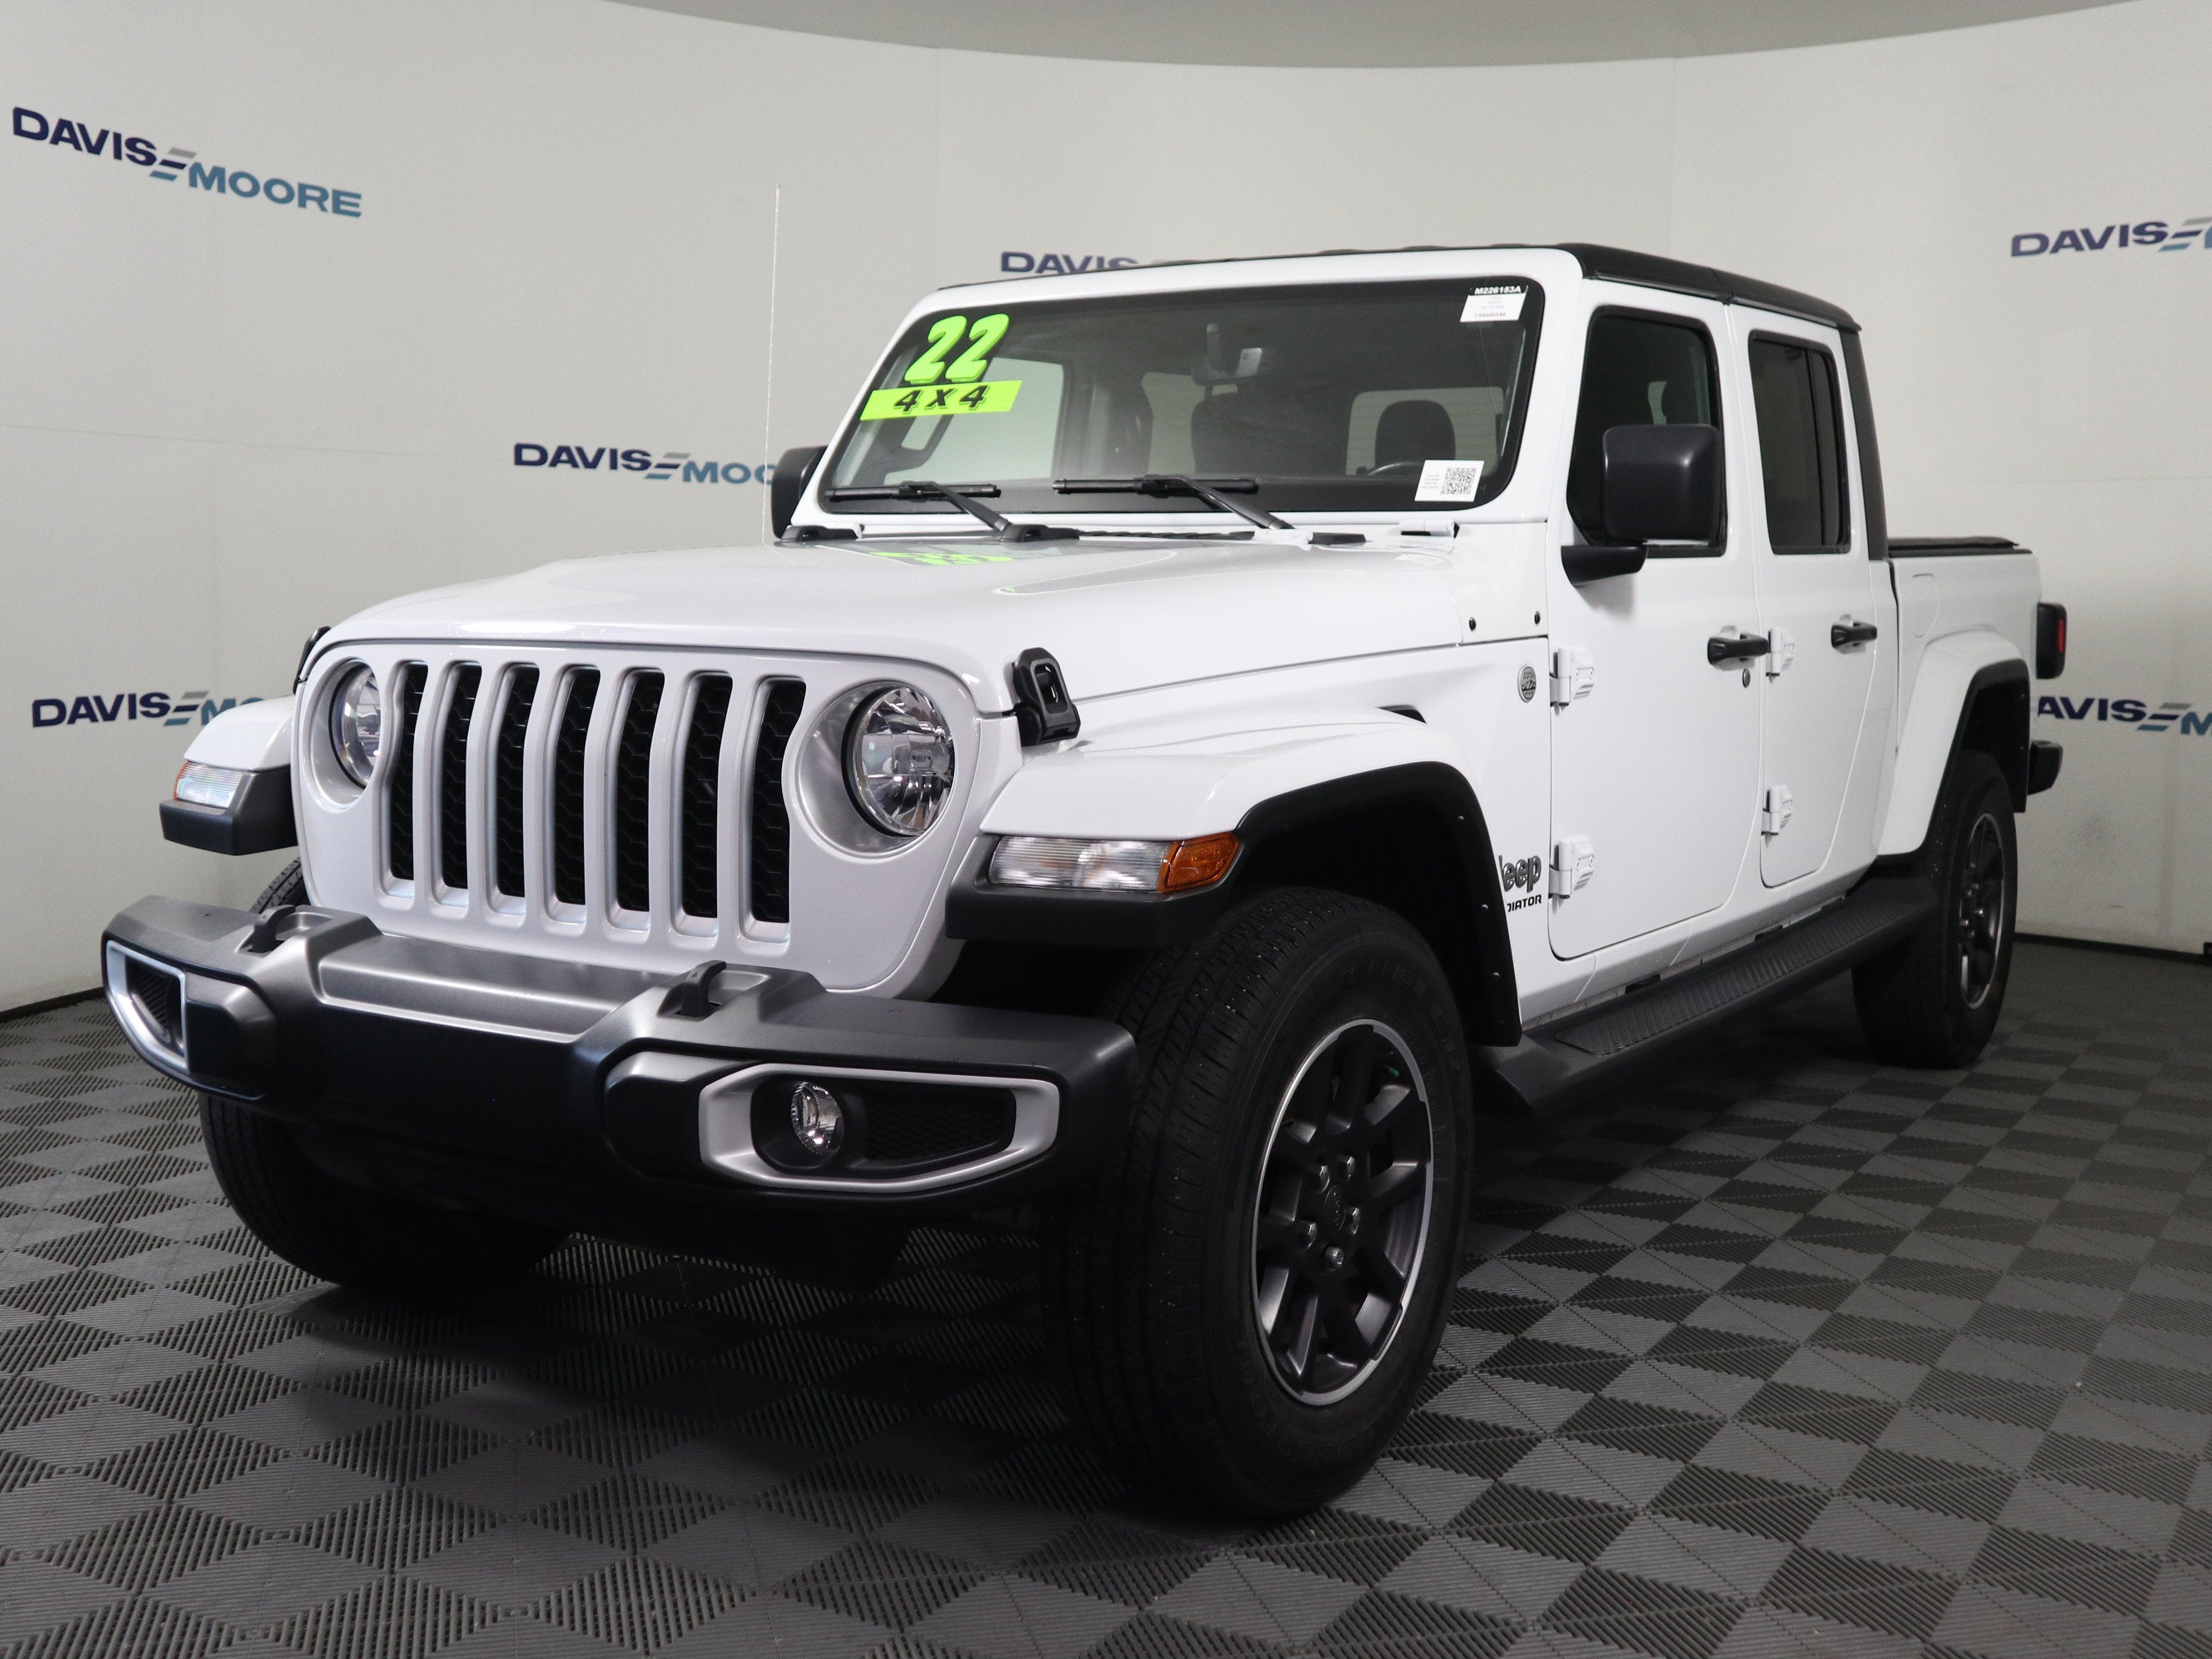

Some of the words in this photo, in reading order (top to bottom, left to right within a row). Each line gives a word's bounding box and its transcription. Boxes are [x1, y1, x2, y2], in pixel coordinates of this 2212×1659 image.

[12, 107, 157, 167] DAVIS
[188, 162, 362, 218] MOORE
[2010, 222, 2169, 257] DAVIS
[904, 313, 1009, 384] 22
[514, 443, 652, 471] DAVIS
[682, 461, 773, 485] MOO
[32, 691, 171, 728] DAVIS
[2038, 695, 2147, 722] AVIS
[1498, 854, 1542, 893] eep
[1507, 894, 1542, 913] DIATOR
